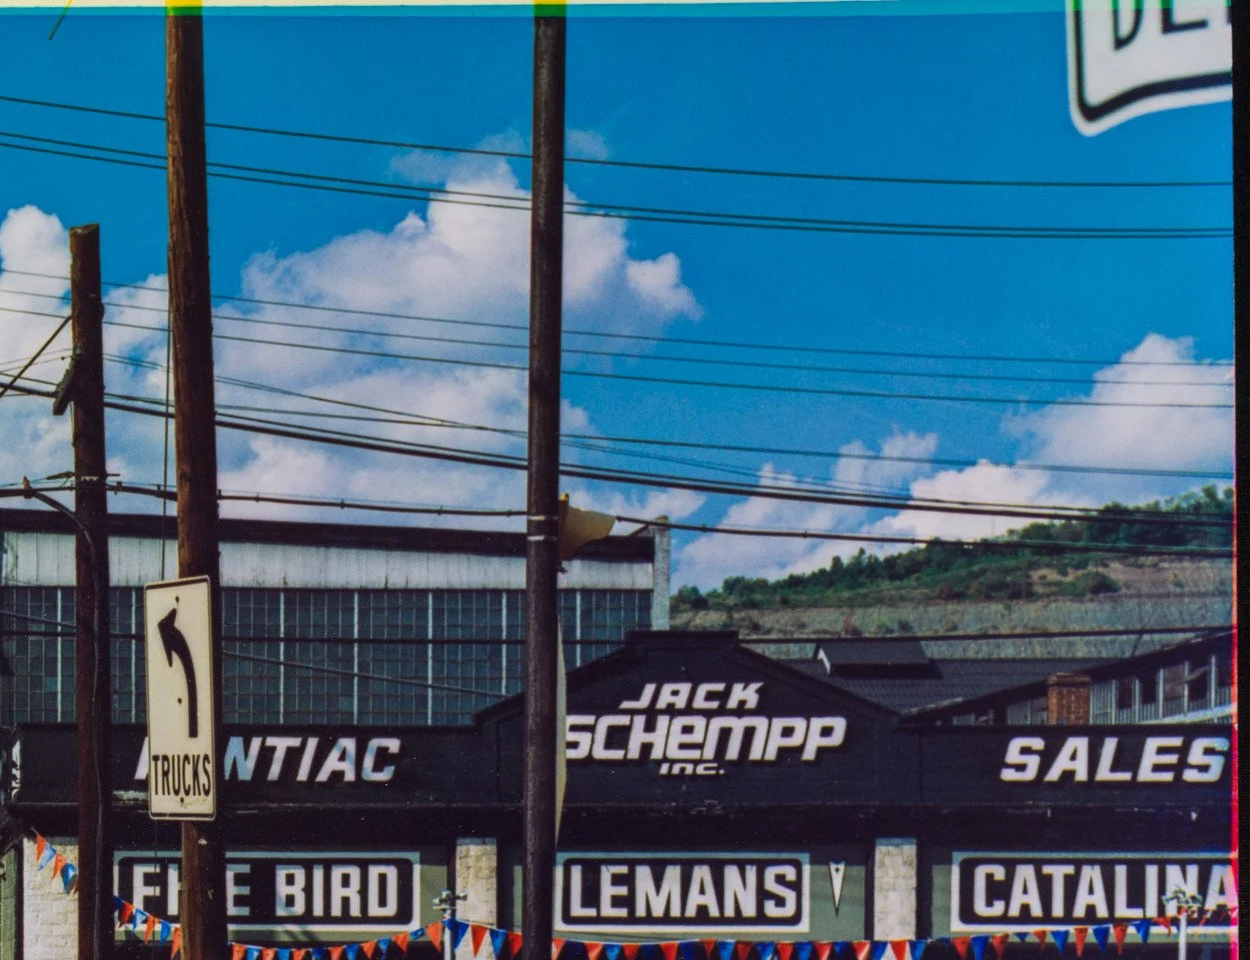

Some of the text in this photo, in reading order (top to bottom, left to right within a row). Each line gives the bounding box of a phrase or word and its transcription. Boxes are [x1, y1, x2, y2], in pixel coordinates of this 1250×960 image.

[618, 682, 764, 710] JACK
[134, 736, 400, 782] NTIAC
[152, 754, 211, 796] TRUCKS
[1000, 736, 1230, 782] SALES
[133, 863, 398, 917] FIE BIRD
[570, 864, 797, 918] LEMANS
[973, 864, 1237, 919] CATALINA
